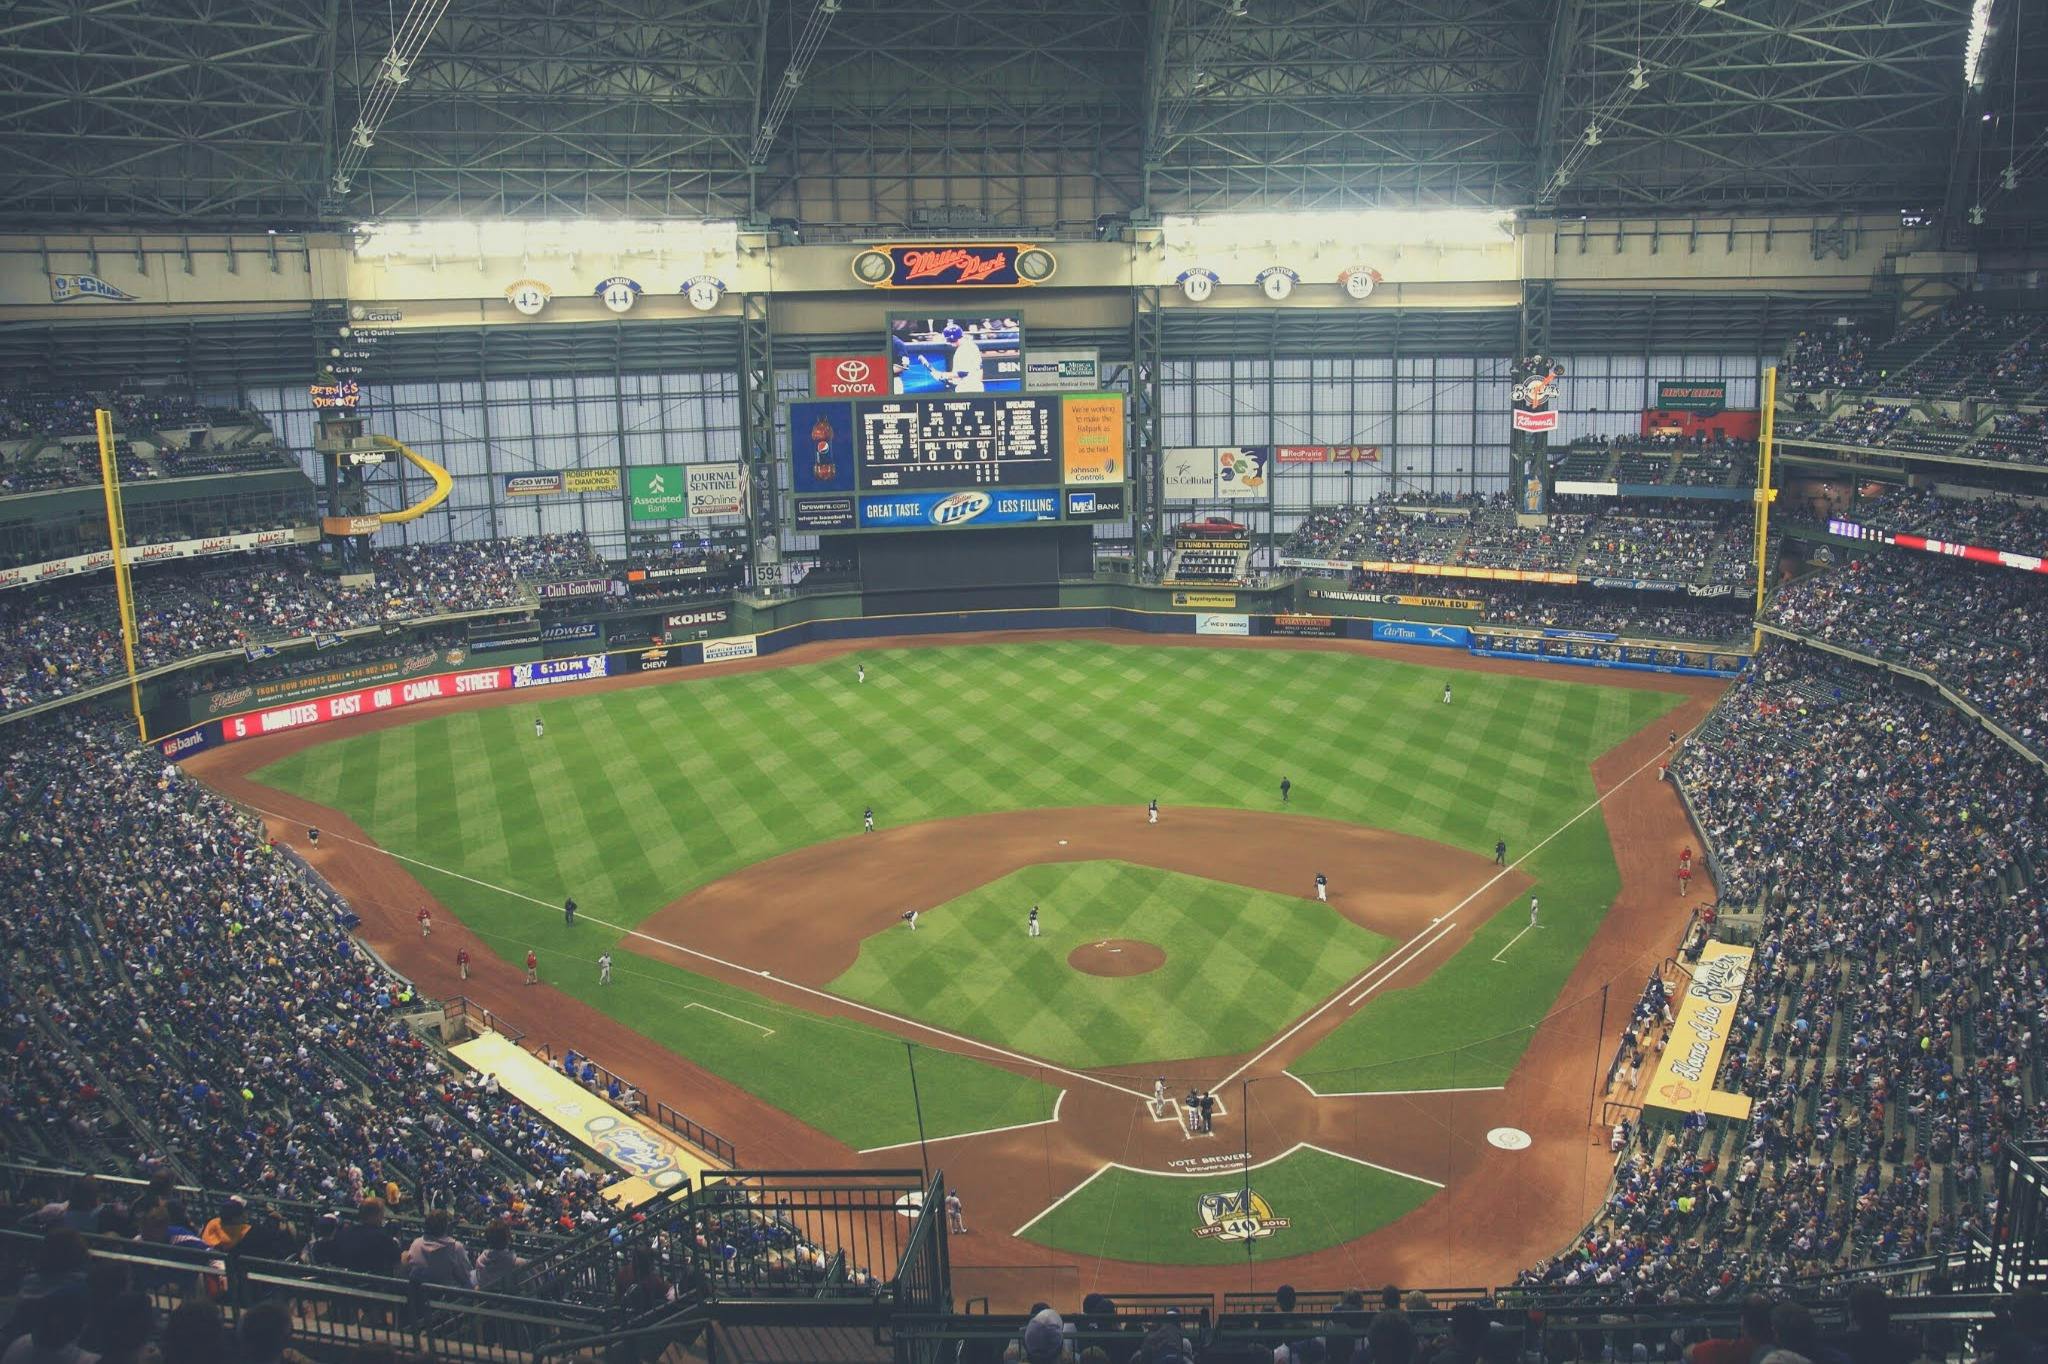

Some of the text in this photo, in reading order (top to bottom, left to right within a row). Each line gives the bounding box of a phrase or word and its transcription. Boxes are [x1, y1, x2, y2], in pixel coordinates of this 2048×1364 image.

[904, 250, 1005, 282] Miller Park
[1262, 268, 1294, 276] MOLITOR
[606, 278, 630, 286] AARON
[1190, 280, 1208, 294] 19
[1272, 280, 1281, 292] 4
[1352, 276, 1368, 288] 50
[518, 292, 539, 306] 42
[608, 291, 628, 304] 44
[694, 289, 712, 302] 34
[310, 380, 358, 397] BERNIE'S
[832, 384, 876, 392] TOYOTA
[882, 404, 900, 412] CUBS
[928, 403, 934, 411] 2
[1091, 406, 1115, 414] working
[1078, 425, 1101, 434] Ballpark
[929, 449, 987, 461] 0 0 0
[691, 472, 736, 482] JOURNAL
[1180, 476, 1212, 484] Cellular
[690, 481, 736, 491] SENTINEL
[634, 494, 681, 504] Associated
[692, 494, 736, 505] JSOnline
[648, 504, 667, 512] Bank
[867, 503, 922, 518] GREAT TASTE.
[942, 500, 983, 523] Lite
[998, 500, 1019, 512] LESS
[258, 531, 287, 542] NYCE
[143, 544, 175, 556] NYCE
[202, 538, 233, 550] NYCE
[88, 553, 110, 565] NYCE
[42, 562, 66, 574] NYCE
[650, 566, 707, 577] HARLEY-DAVIDSON
[758, 567, 782, 580] 594
[548, 580, 606, 597] Club Goodwill
[1422, 599, 1468, 608] UWM.EDU
[668, 611, 727, 626] KOHL'S
[540, 624, 595, 638] MIDWEST
[541, 661, 583, 674] 6:10 PM
[642, 660, 667, 670] CHEVY
[256, 673, 345, 696] FRONT ROW SPORTS GRILL
[551, 674, 577, 683] BREWERS
[236, 672, 500, 737] 5 MINUTES EAST ON CANAL STREET
[164, 731, 203, 756] usbank
[1696, 1006, 1721, 1026] the
[1689, 1020, 1720, 1042] of
[1671, 1042, 1710, 1082] Home
[1168, 1153, 1252, 1168] VOTE BREWERS
[1186, 1162, 1244, 1173] brewers.com
[1198, 1226, 1222, 1235] 1970
[1228, 1220, 1256, 1233] 40
